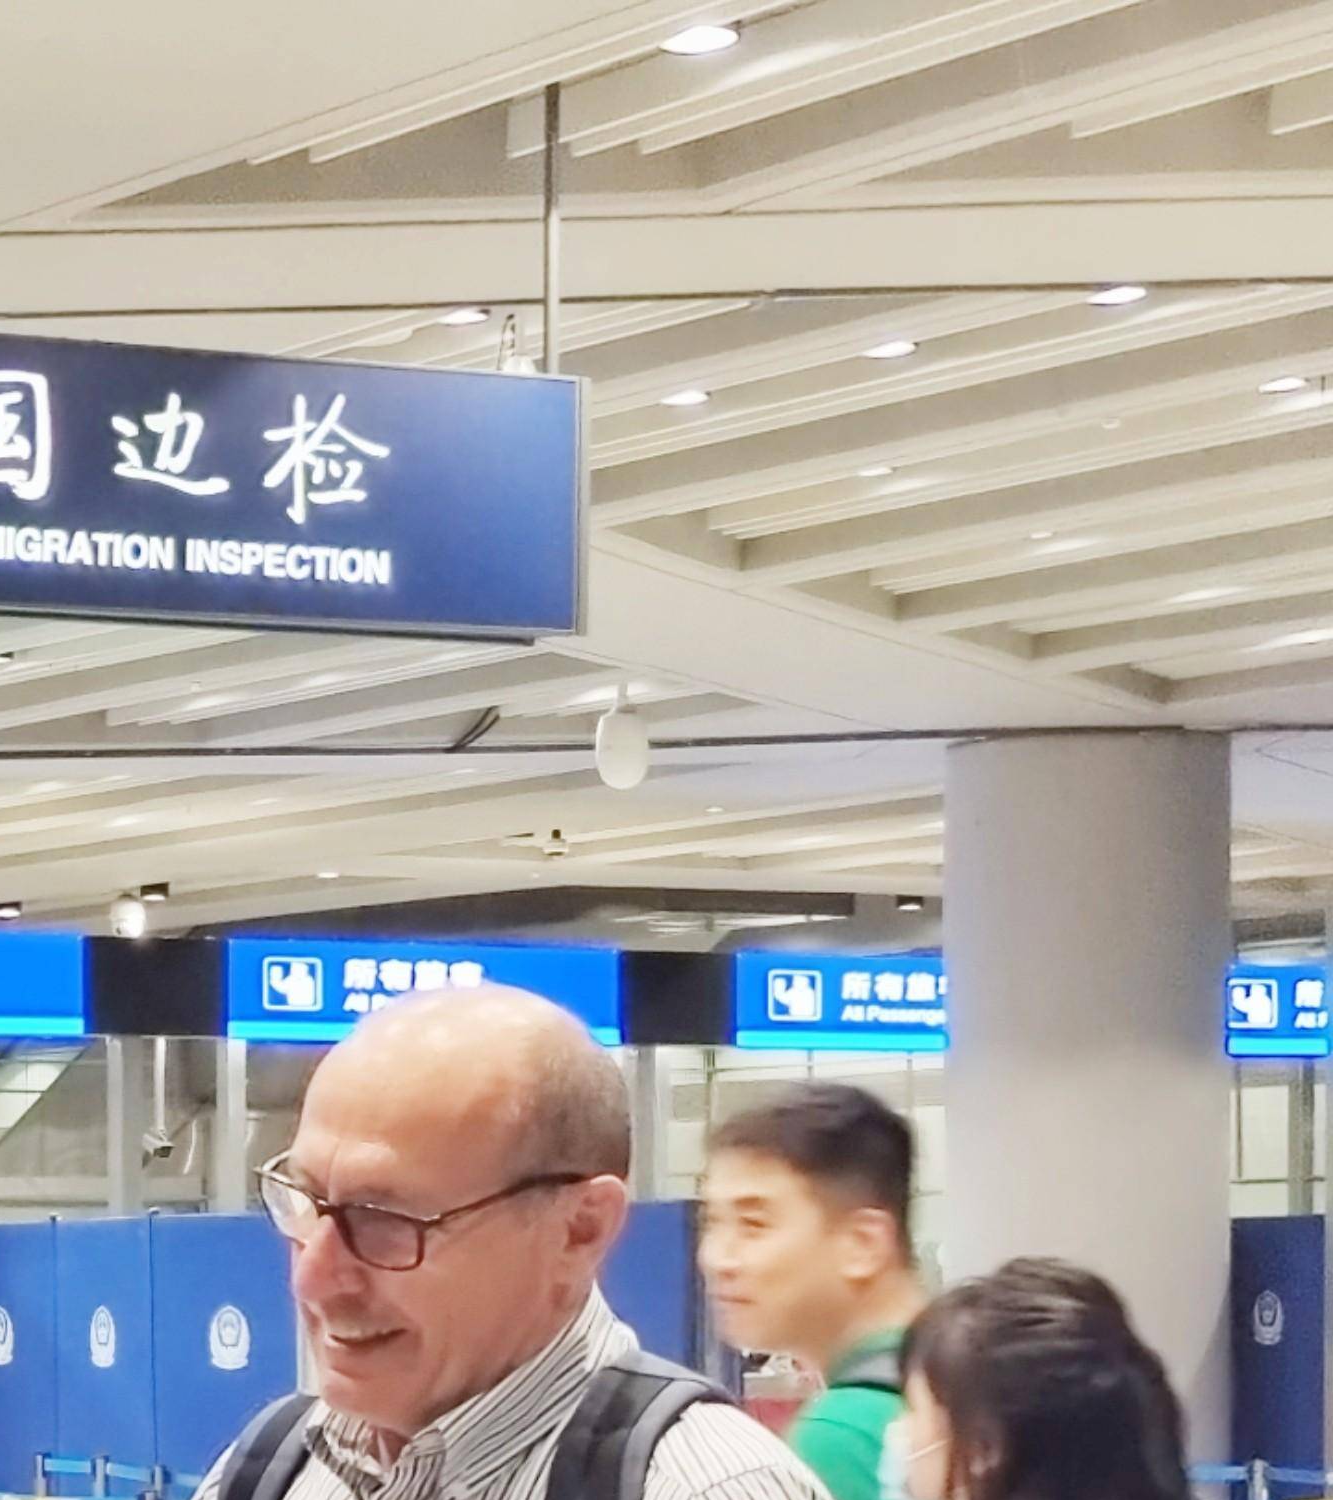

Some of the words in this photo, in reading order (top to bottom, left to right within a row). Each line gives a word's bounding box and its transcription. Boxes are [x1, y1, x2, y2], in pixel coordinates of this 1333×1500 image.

[185, 539, 391, 585] INSPECTION
[841, 971, 948, 1001] 所有旅
